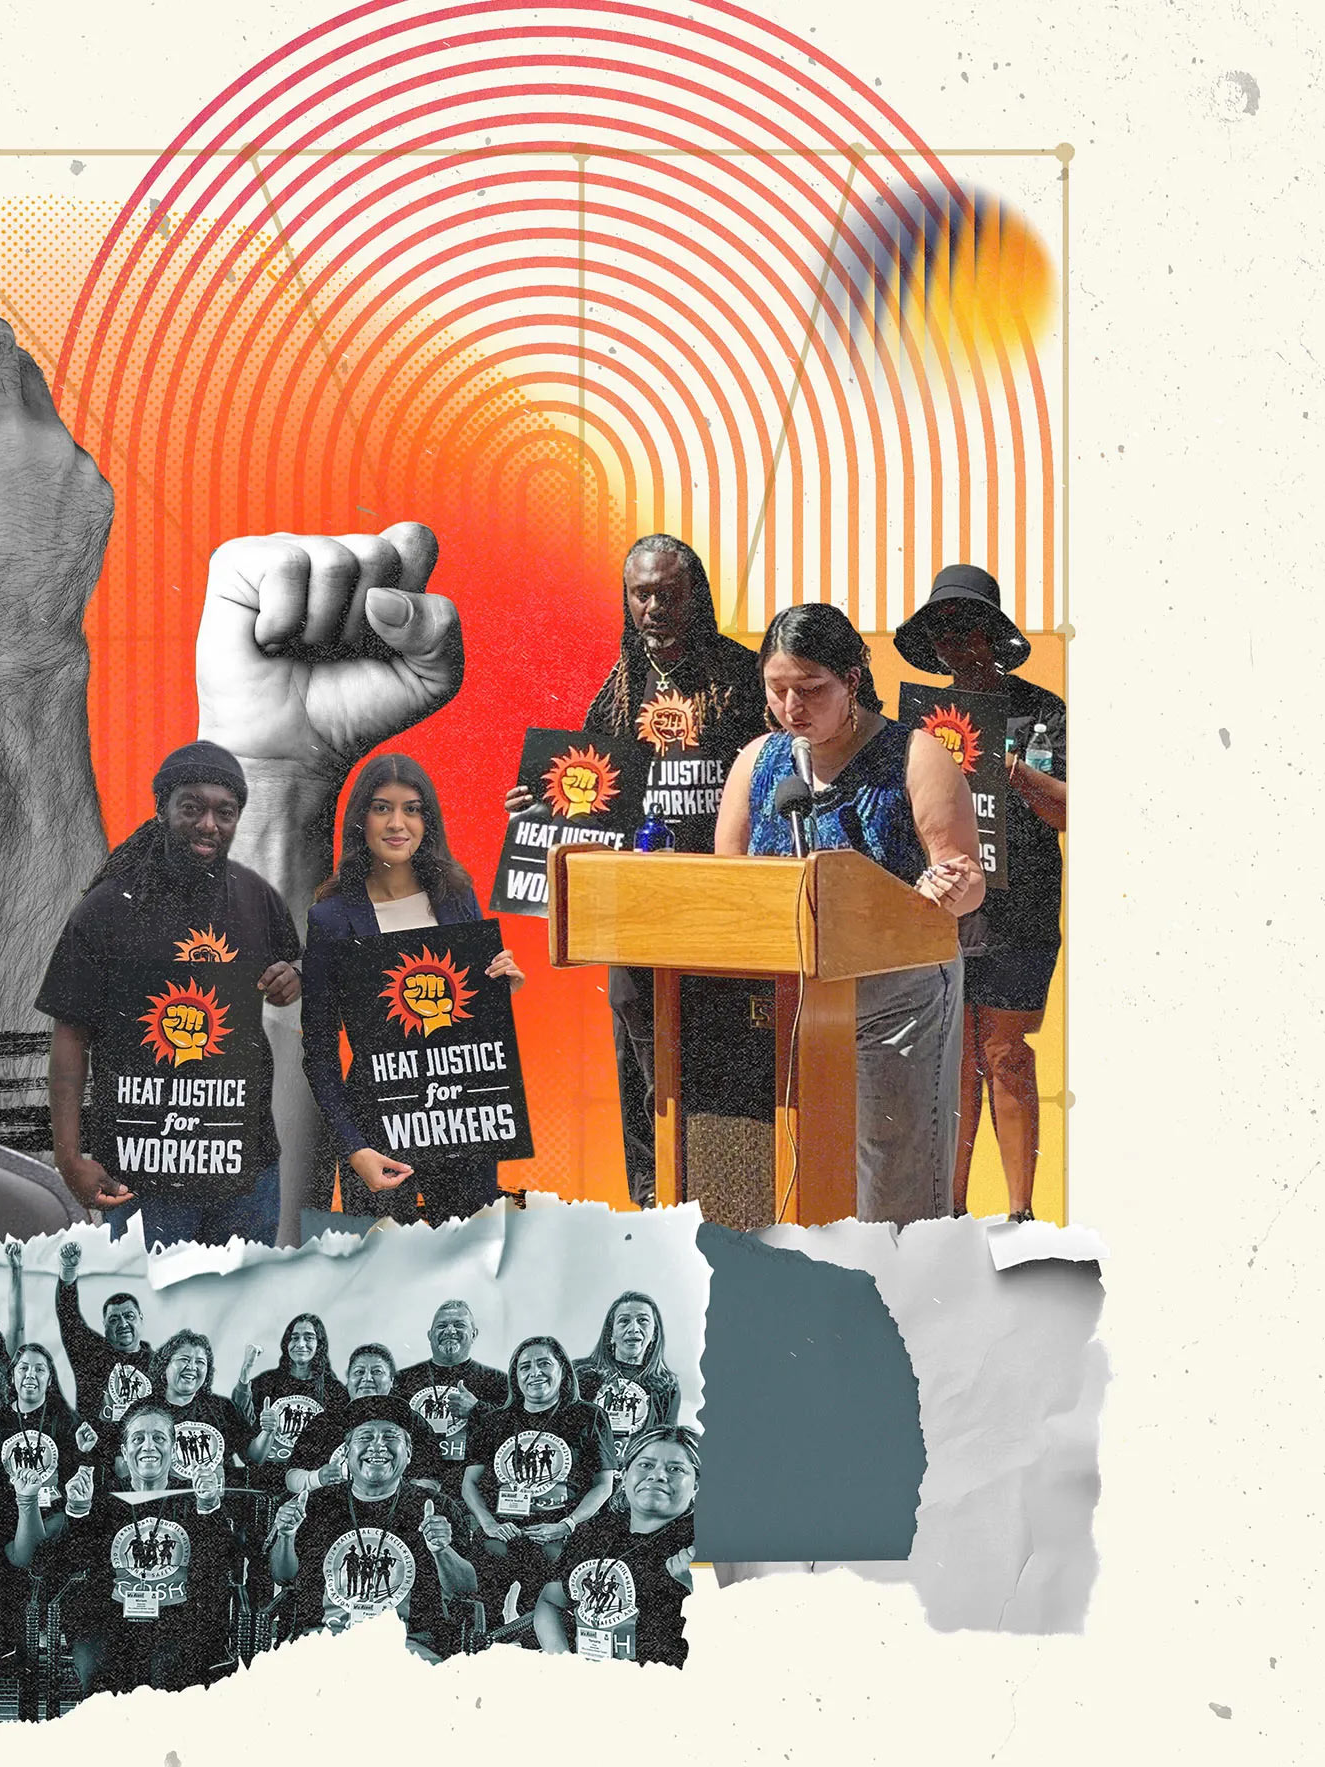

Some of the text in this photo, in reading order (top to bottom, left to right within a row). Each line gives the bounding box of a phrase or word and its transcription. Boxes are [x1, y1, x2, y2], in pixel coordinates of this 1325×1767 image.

[658, 760, 724, 786] JUSTICE
[515, 821, 559, 849] HEAT
[371, 1041, 507, 1082] HEAT JUSTICE
[117, 1076, 246, 1107] HEAT JUSTICE
[424, 1082, 463, 1108] for
[160, 1112, 200, 1136] for
[382, 1103, 517, 1151] WORKERS
[116, 1136, 243, 1174] WORKERS
[336, 1529, 371, 1546] NATIOAL
